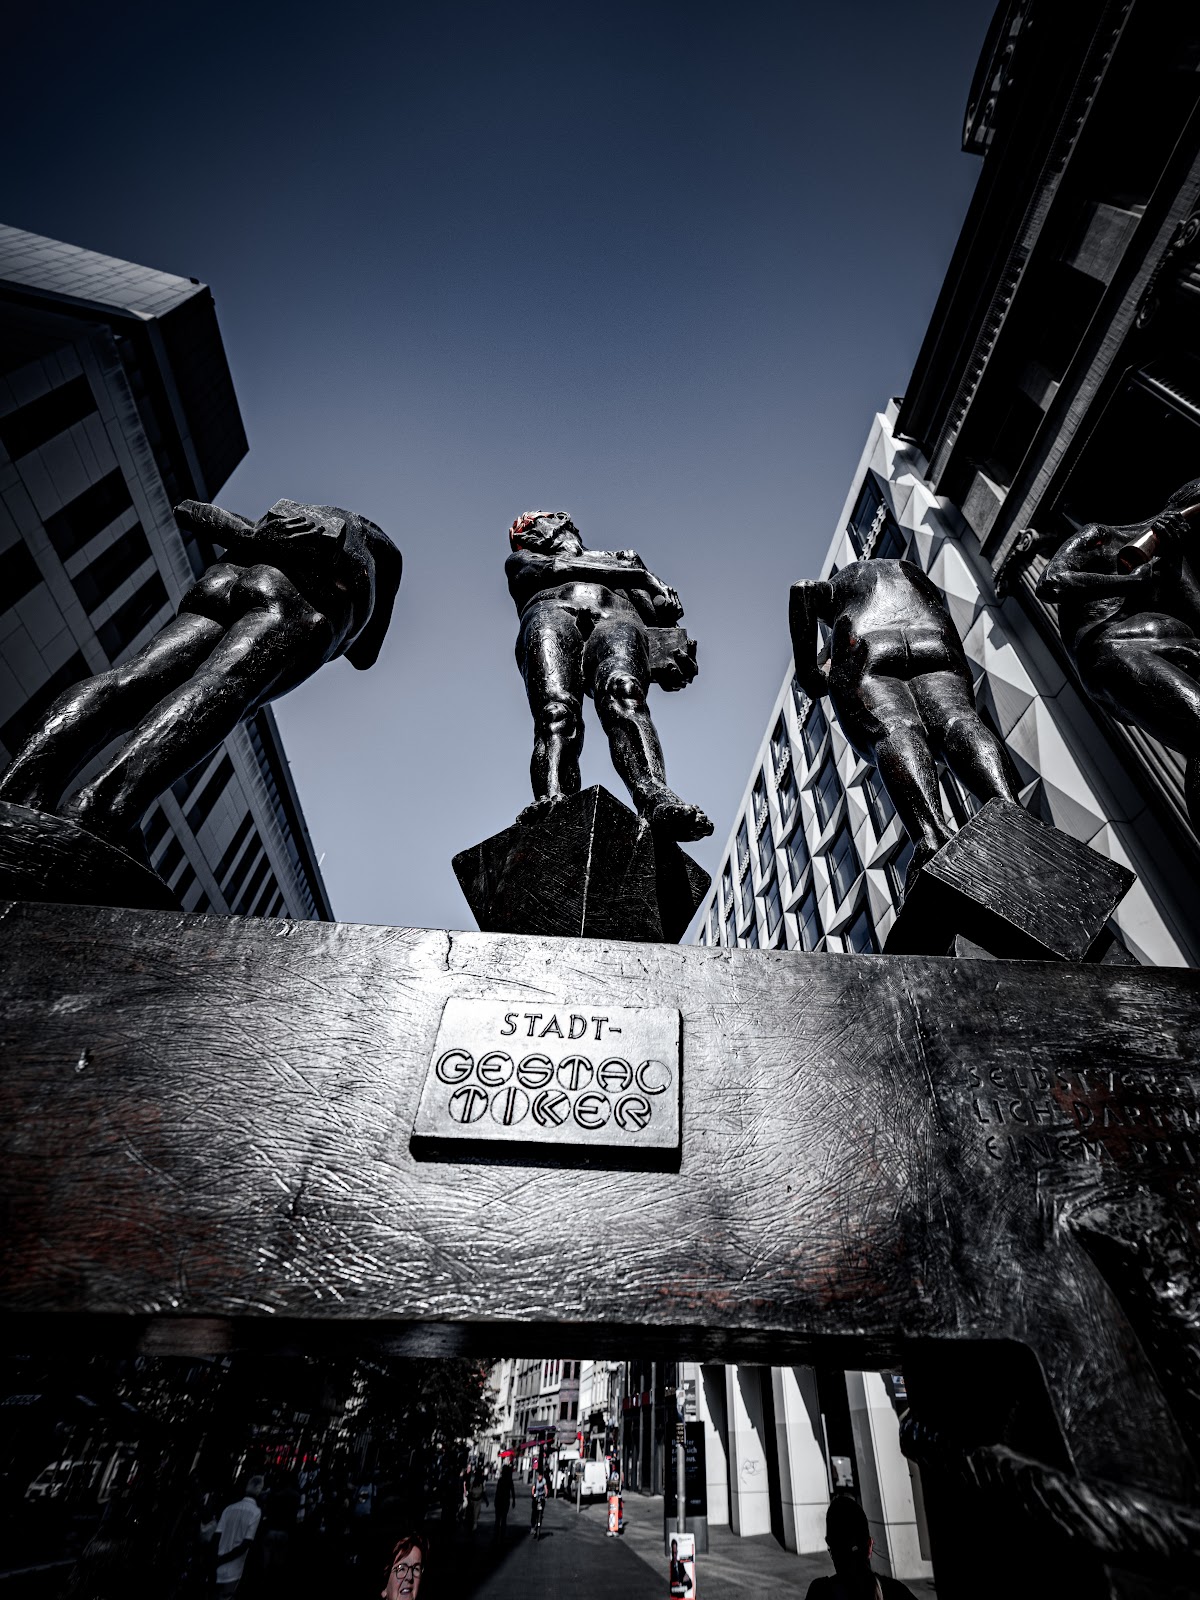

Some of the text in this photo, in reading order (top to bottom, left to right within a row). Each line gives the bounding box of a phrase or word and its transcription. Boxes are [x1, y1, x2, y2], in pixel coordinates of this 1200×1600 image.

[501, 1012, 621, 1041] STADT-
[449, 1084, 652, 1132] TIKER
[973, 1099, 1056, 1126] LICH
[1074, 1101, 1164, 1128] DARF
